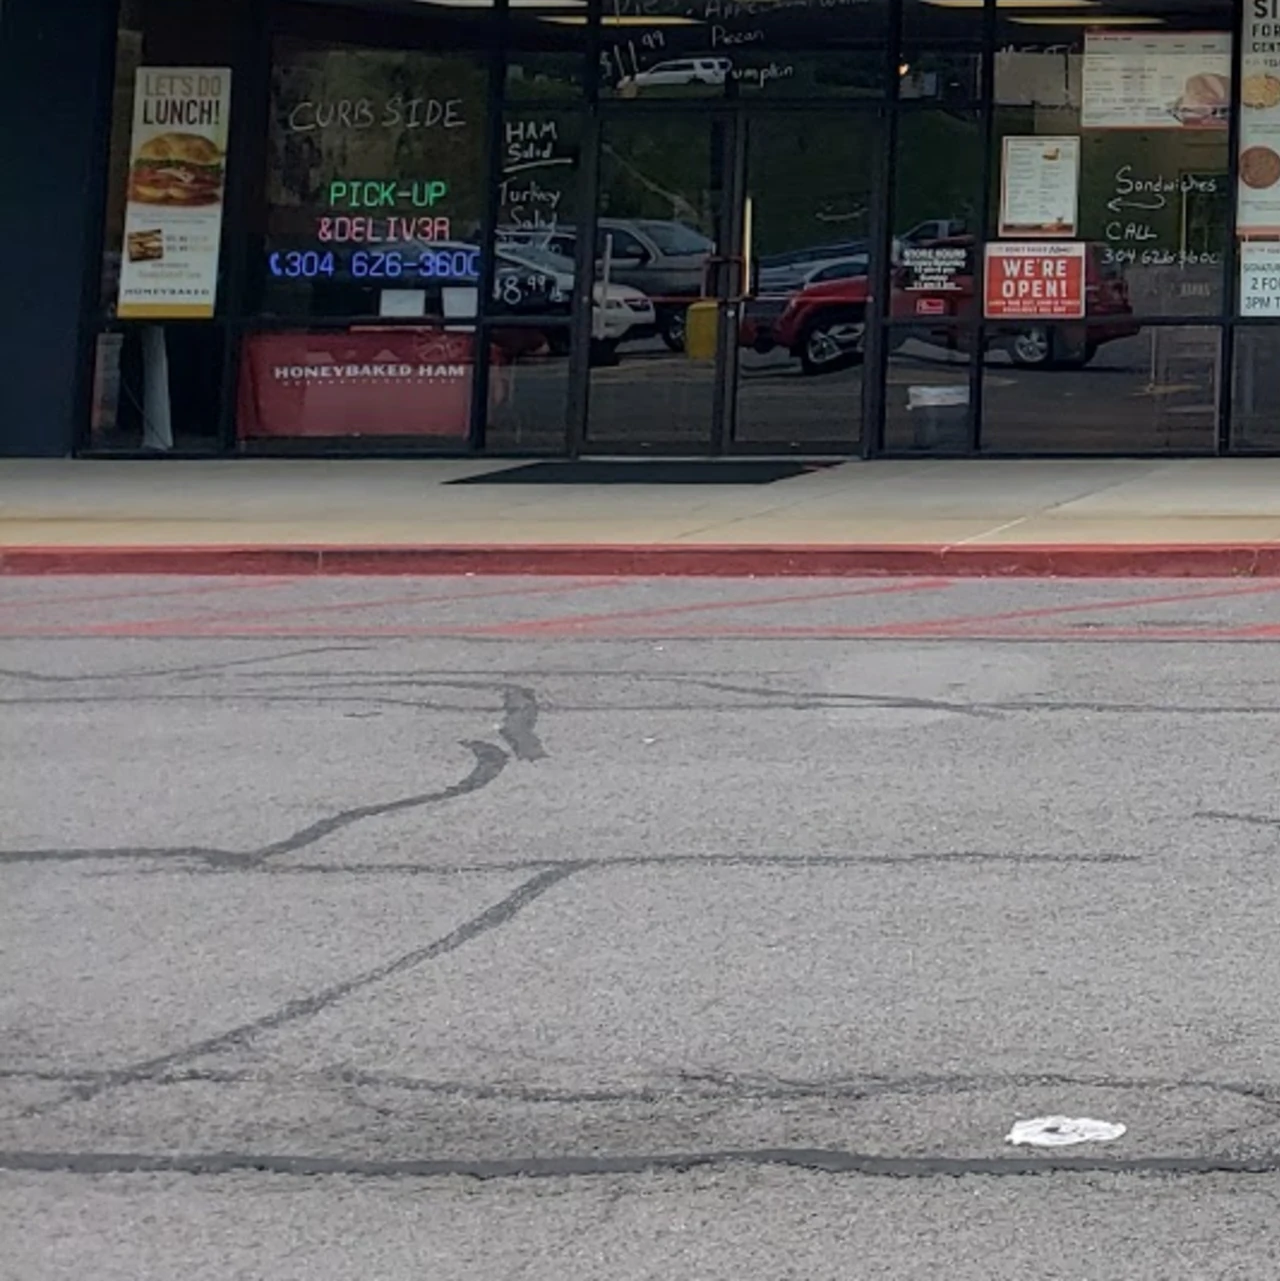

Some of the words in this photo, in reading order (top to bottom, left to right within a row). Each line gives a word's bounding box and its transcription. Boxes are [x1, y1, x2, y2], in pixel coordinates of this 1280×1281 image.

[144, 74, 194, 98] LET'S
[197, 74, 222, 98] DO
[143, 99, 220, 125] LUNCH!
[505, 121, 558, 143] HAM
[329, 181, 447, 207] PICK-UP
[1106, 222, 1158, 240] CALL
[284, 251, 335, 277] 304
[1002, 259, 1068, 277] WE'RE
[1002, 280, 1068, 298] OPEN!
[1250, 277, 1259, 290] 2
[274, 364, 413, 380] HONEYBAKED
[418, 364, 465, 378] HAM
